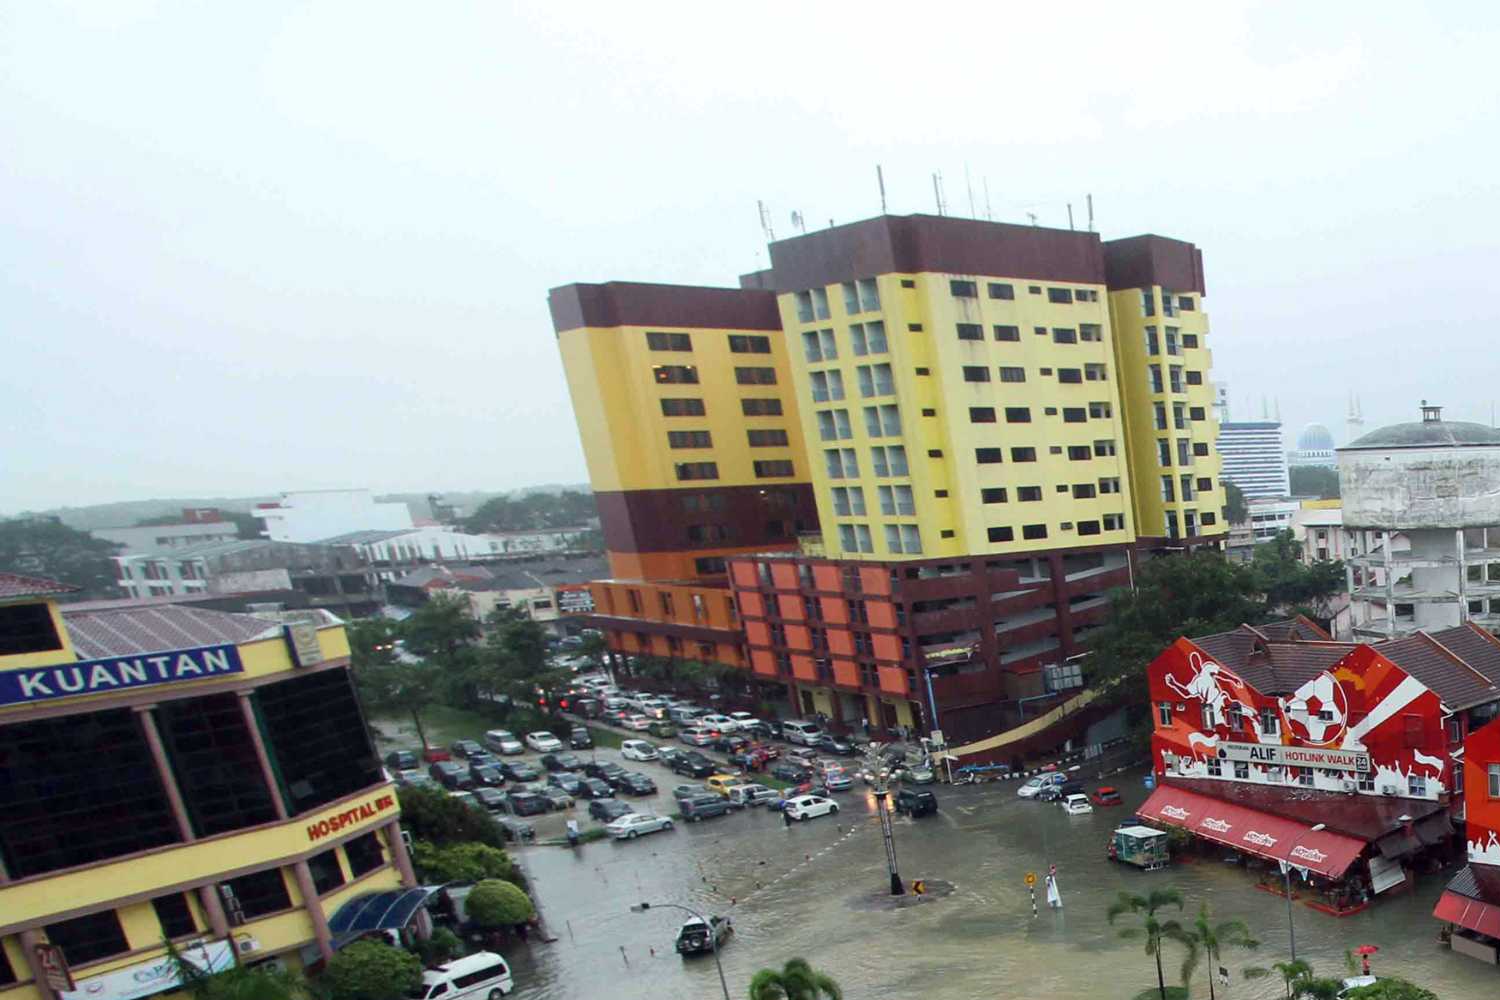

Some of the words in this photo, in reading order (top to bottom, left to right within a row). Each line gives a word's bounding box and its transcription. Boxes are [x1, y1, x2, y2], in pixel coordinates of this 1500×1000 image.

[17, 648, 231, 699] KUANTAN
[1250, 749, 1277, 761] ALIF
[1285, 751, 1325, 763] HOTLINK
[1327, 755, 1356, 766] WALK
[306, 802, 377, 841] HOSPITAL
